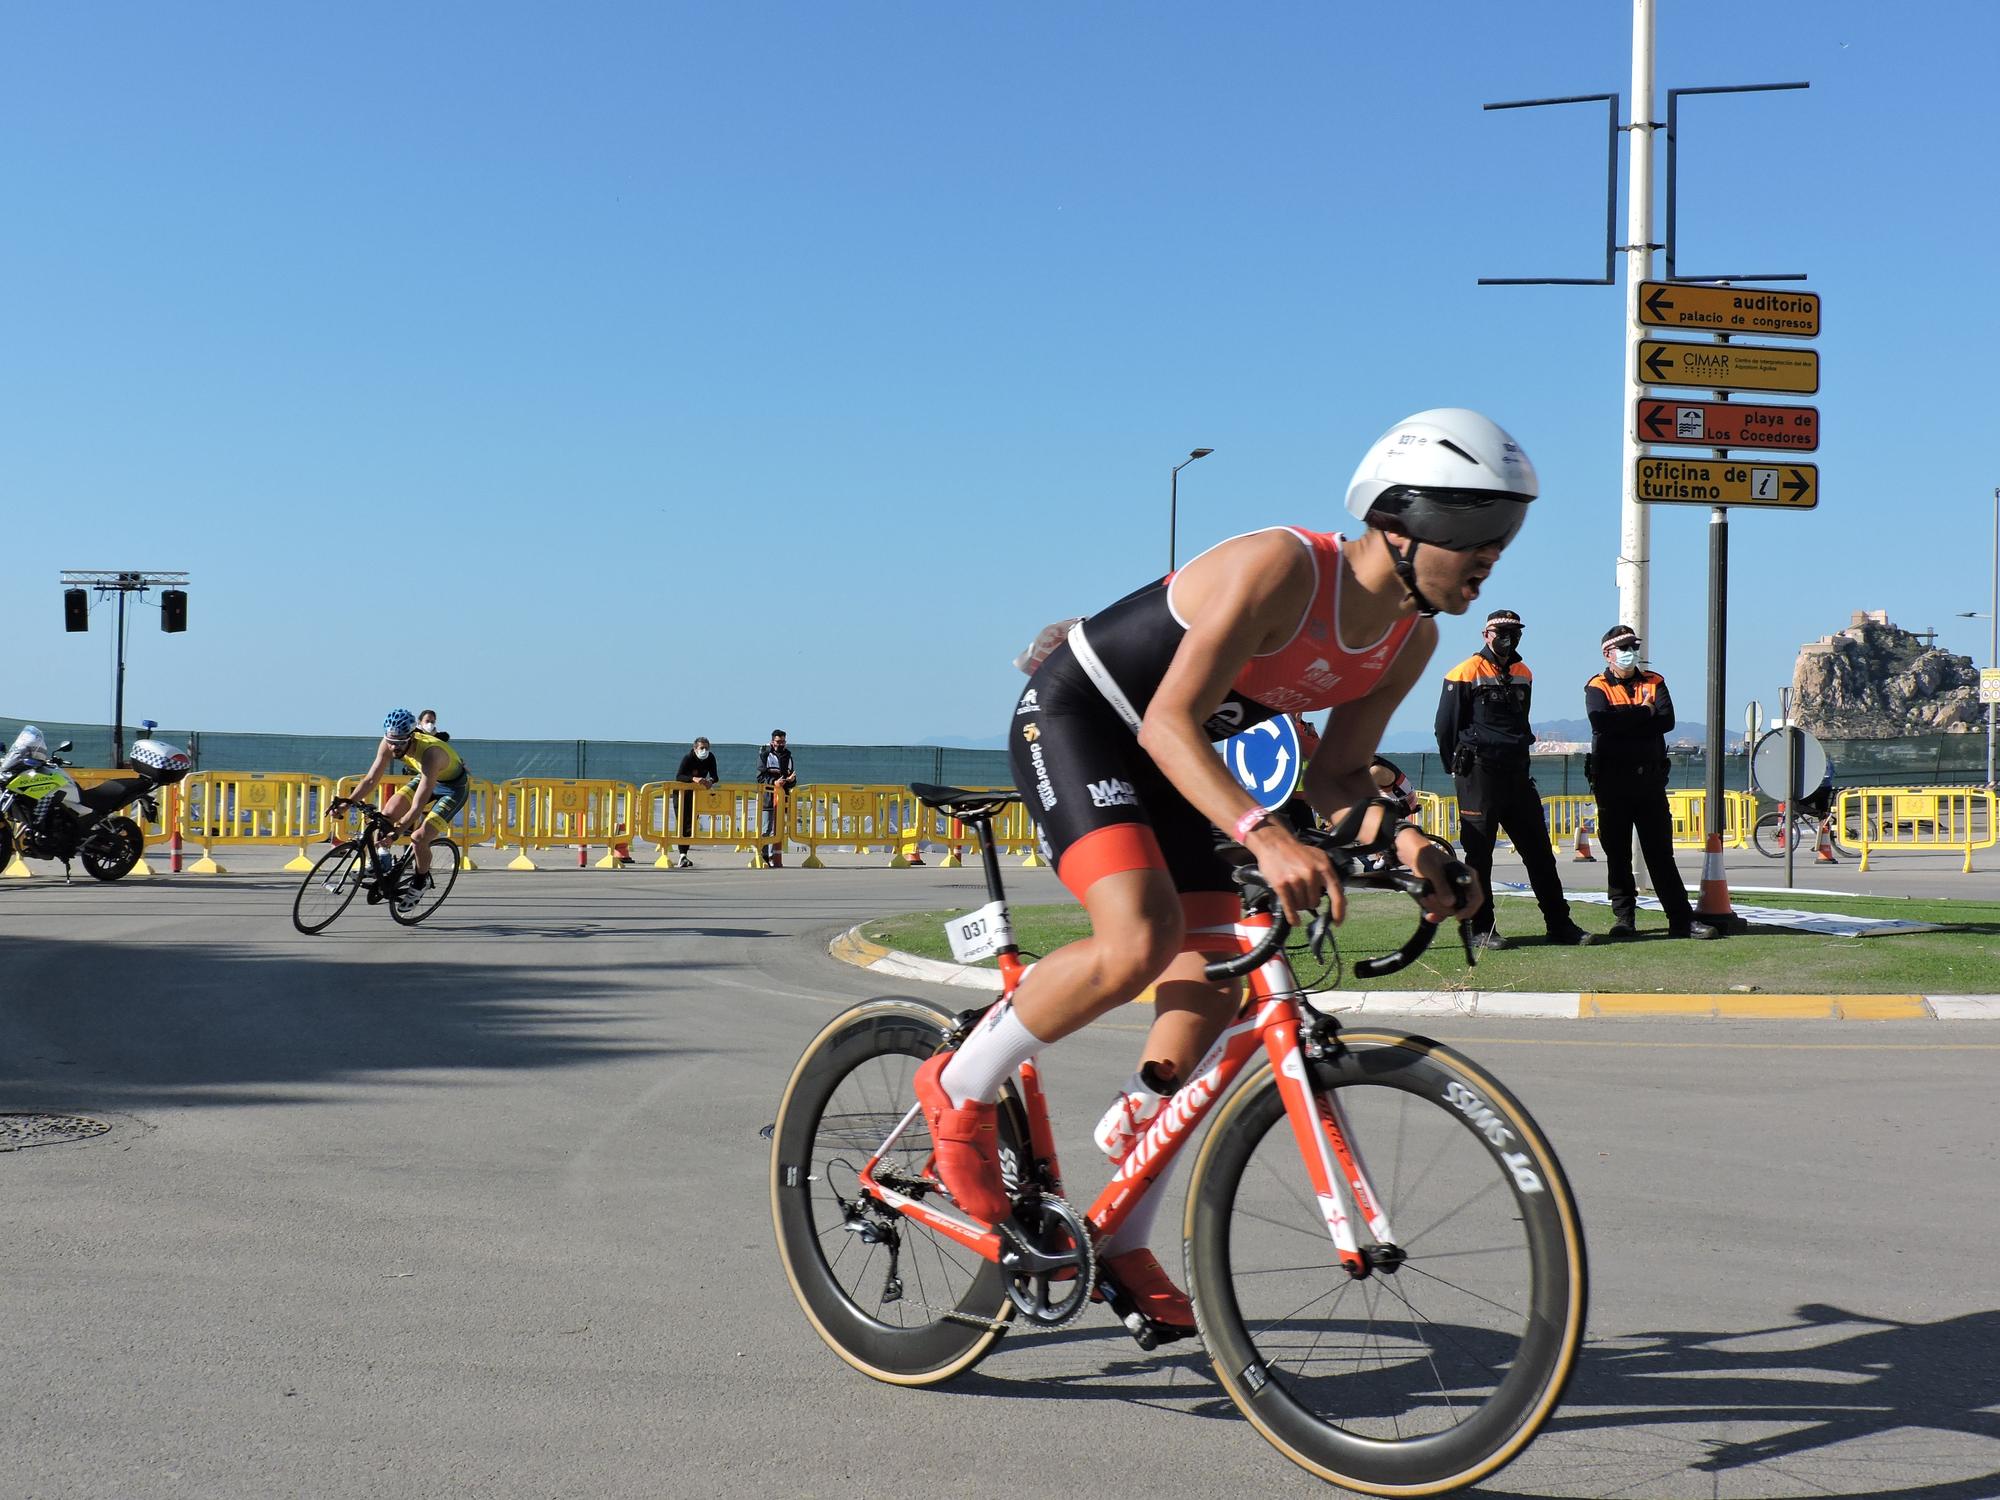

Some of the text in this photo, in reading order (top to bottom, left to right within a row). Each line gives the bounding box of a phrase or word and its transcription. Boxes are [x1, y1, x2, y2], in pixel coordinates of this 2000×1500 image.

[1733, 296, 1812, 313] auditorio
[1679, 311, 1813, 329] palacio de congresos
[1683, 352, 1729, 368] CIMAR
[1744, 411, 1812, 426] playa de
[1707, 428, 1812, 444] Los Cocedores
[1643, 462, 1747, 483] oficina de
[1643, 480, 1720, 499] turismo
[1086, 777, 1135, 800] MAD
[962, 918, 987, 941] 037
[1441, 1081, 1545, 1194] DT SWISS
